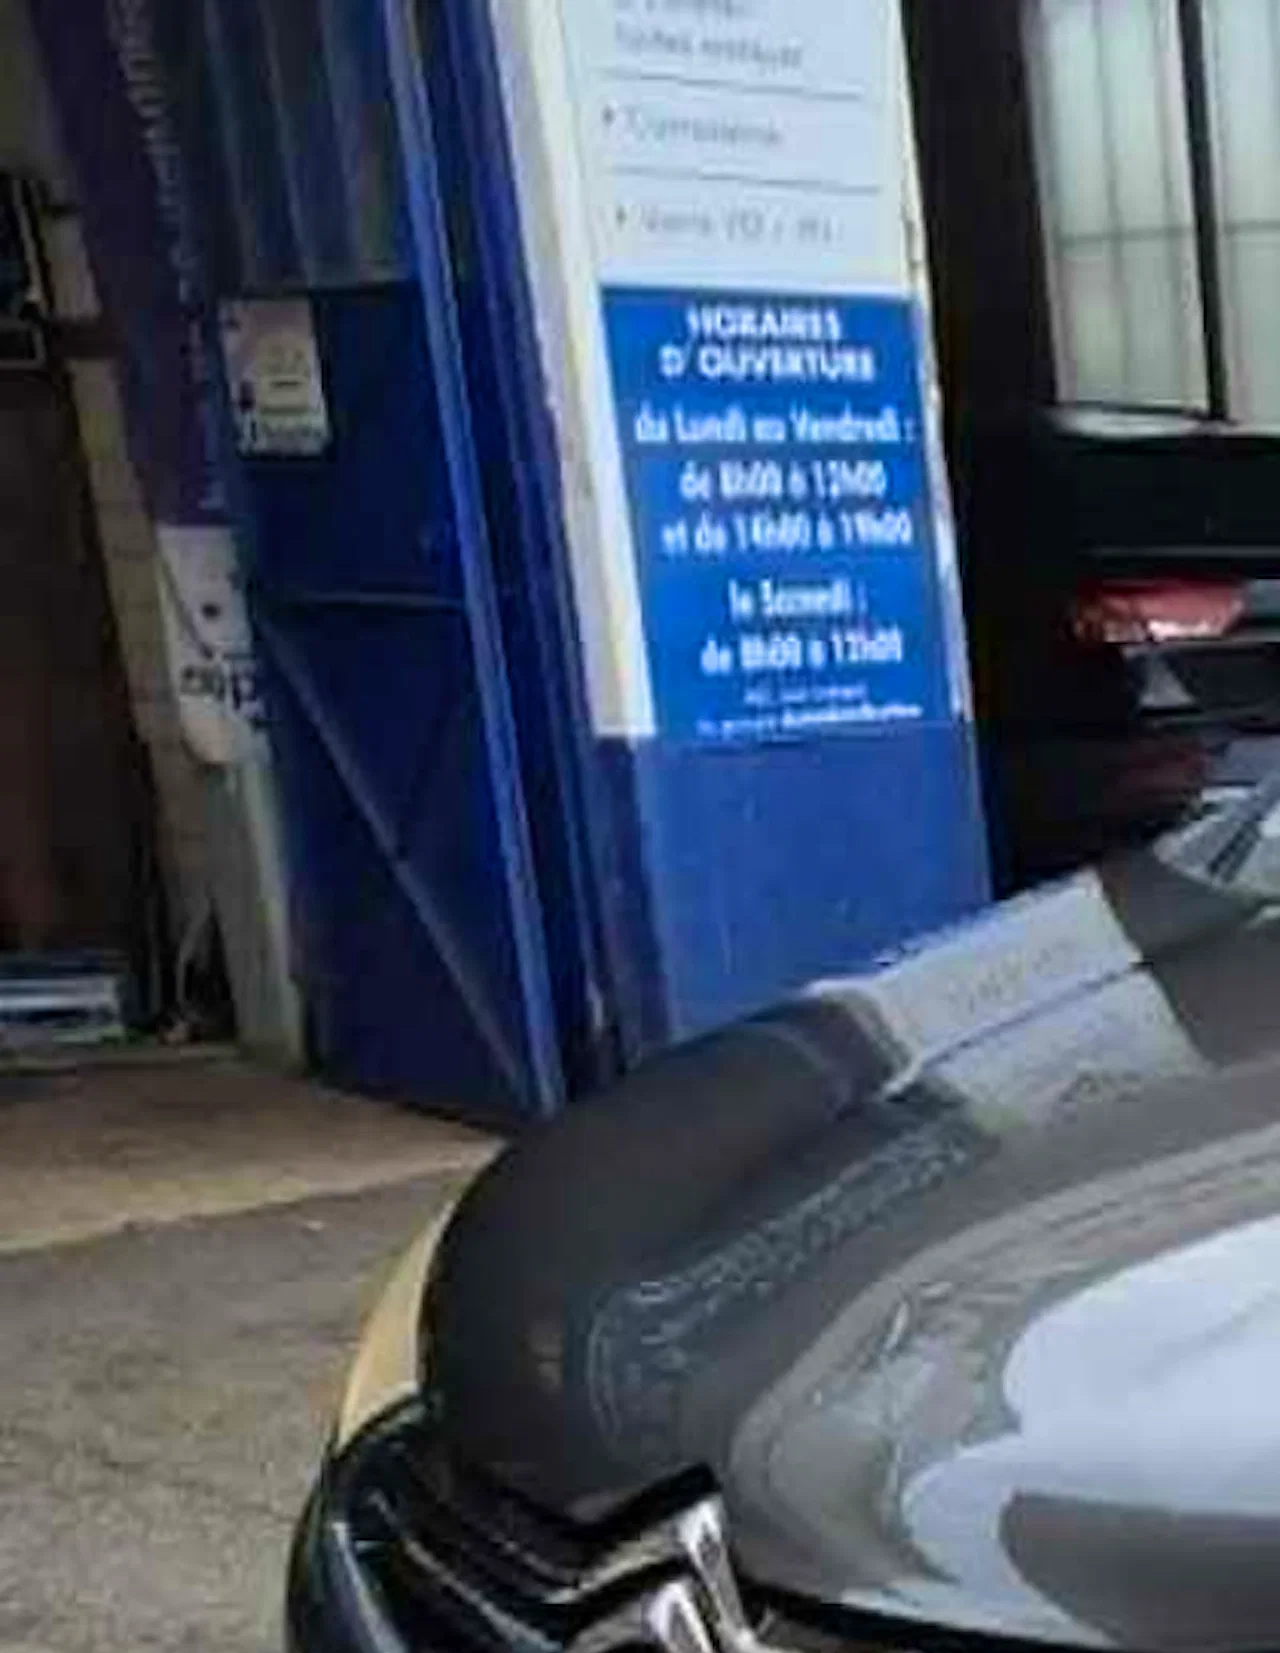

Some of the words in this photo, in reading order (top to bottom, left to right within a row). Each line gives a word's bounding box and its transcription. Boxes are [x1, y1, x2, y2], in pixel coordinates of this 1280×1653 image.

[686, 302, 843, 341] HORAIRES
[674, 402, 746, 441] Lundi
[790, 401, 899, 441] Vendredi
